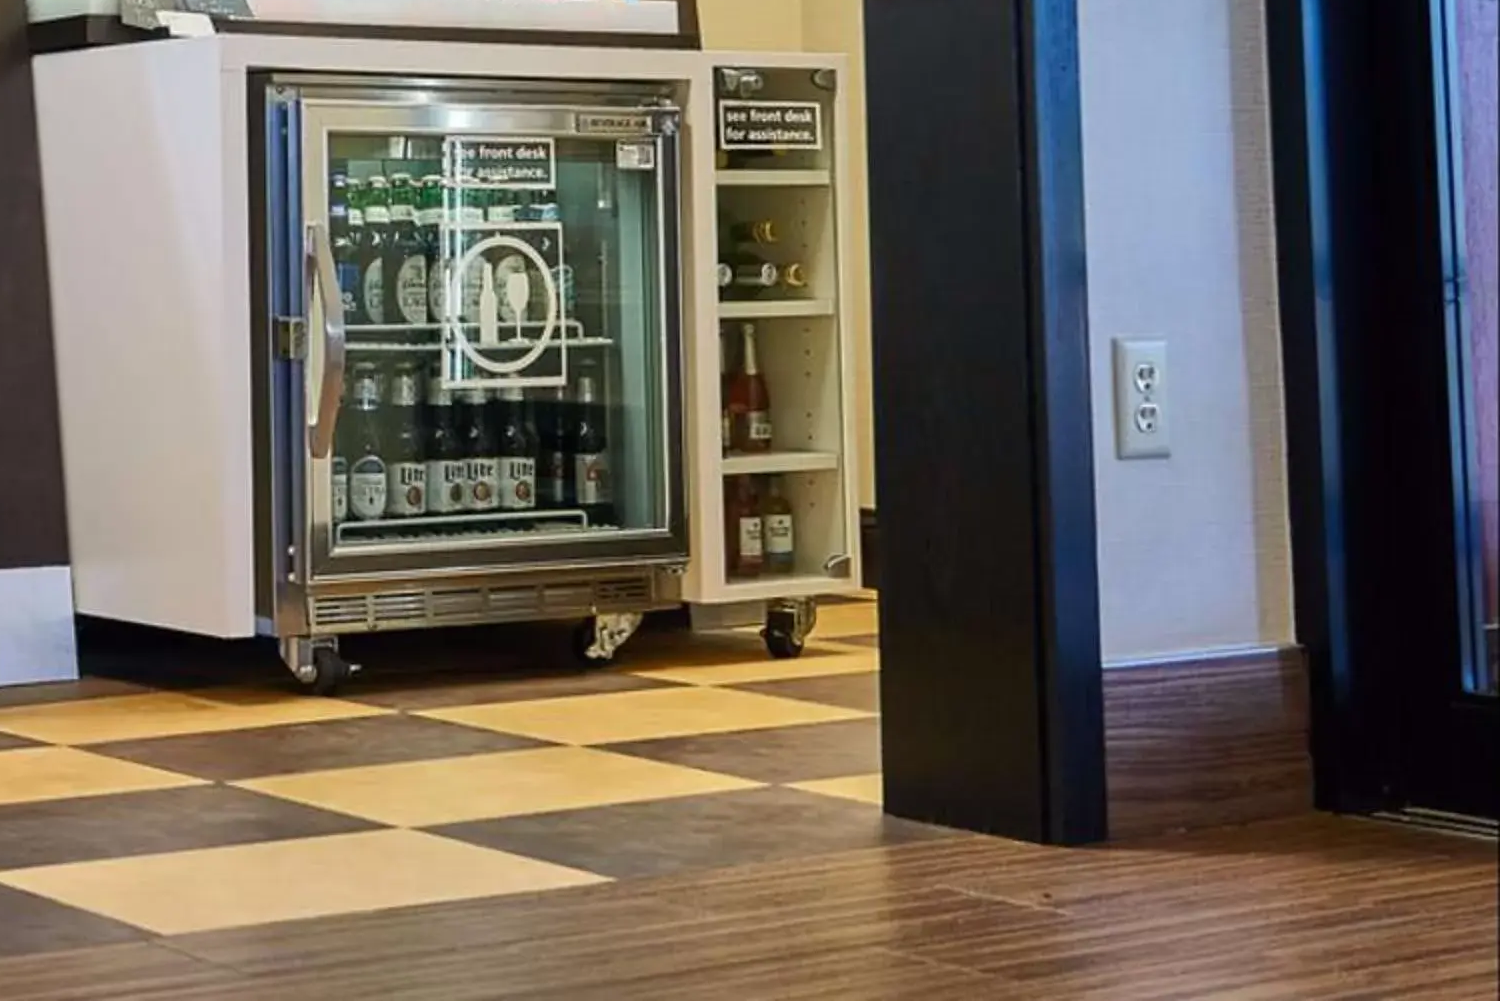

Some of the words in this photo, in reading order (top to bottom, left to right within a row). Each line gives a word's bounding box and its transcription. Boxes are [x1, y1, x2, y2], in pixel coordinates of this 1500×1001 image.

[725, 110, 748, 123] see
[749, 109, 782, 123] front
[783, 109, 813, 124] desk
[725, 126, 746, 140] for
[747, 128, 815, 142] assistance.
[479, 144, 514, 160] front
[515, 145, 548, 160] desk
